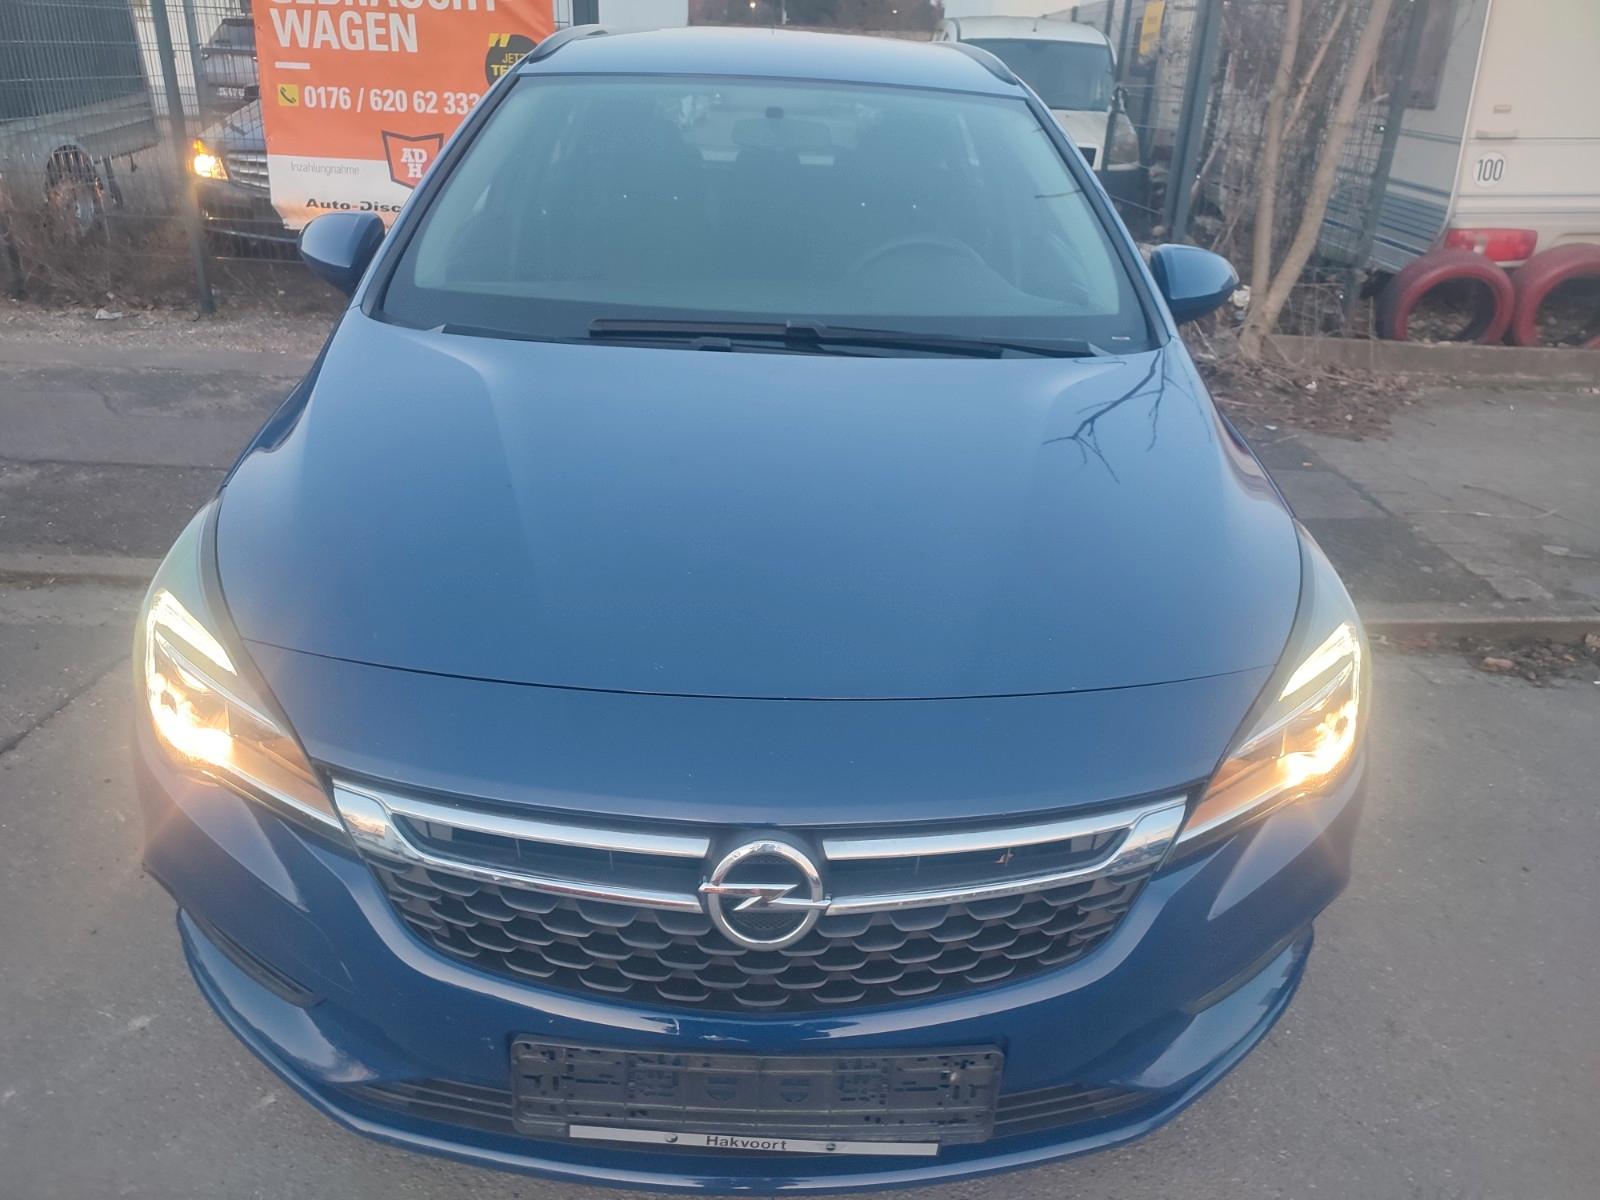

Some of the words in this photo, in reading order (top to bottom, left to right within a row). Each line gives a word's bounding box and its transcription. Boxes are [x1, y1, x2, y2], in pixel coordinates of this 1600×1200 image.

[269, 8, 418, 52] WAGEN
[490, 64, 512, 76] TE
[304, 86, 351, 110] 0176
[356, 88, 365, 113] /
[369, 89, 408, 113] 620
[412, 90, 438, 114] 62
[401, 148, 427, 163] AD
[291, 161, 360, 176] Inzahlungnahme
[407, 163, 424, 178] H
[1477, 159, 1504, 182] 100
[706, 1135, 787, 1151] Hakvoort
